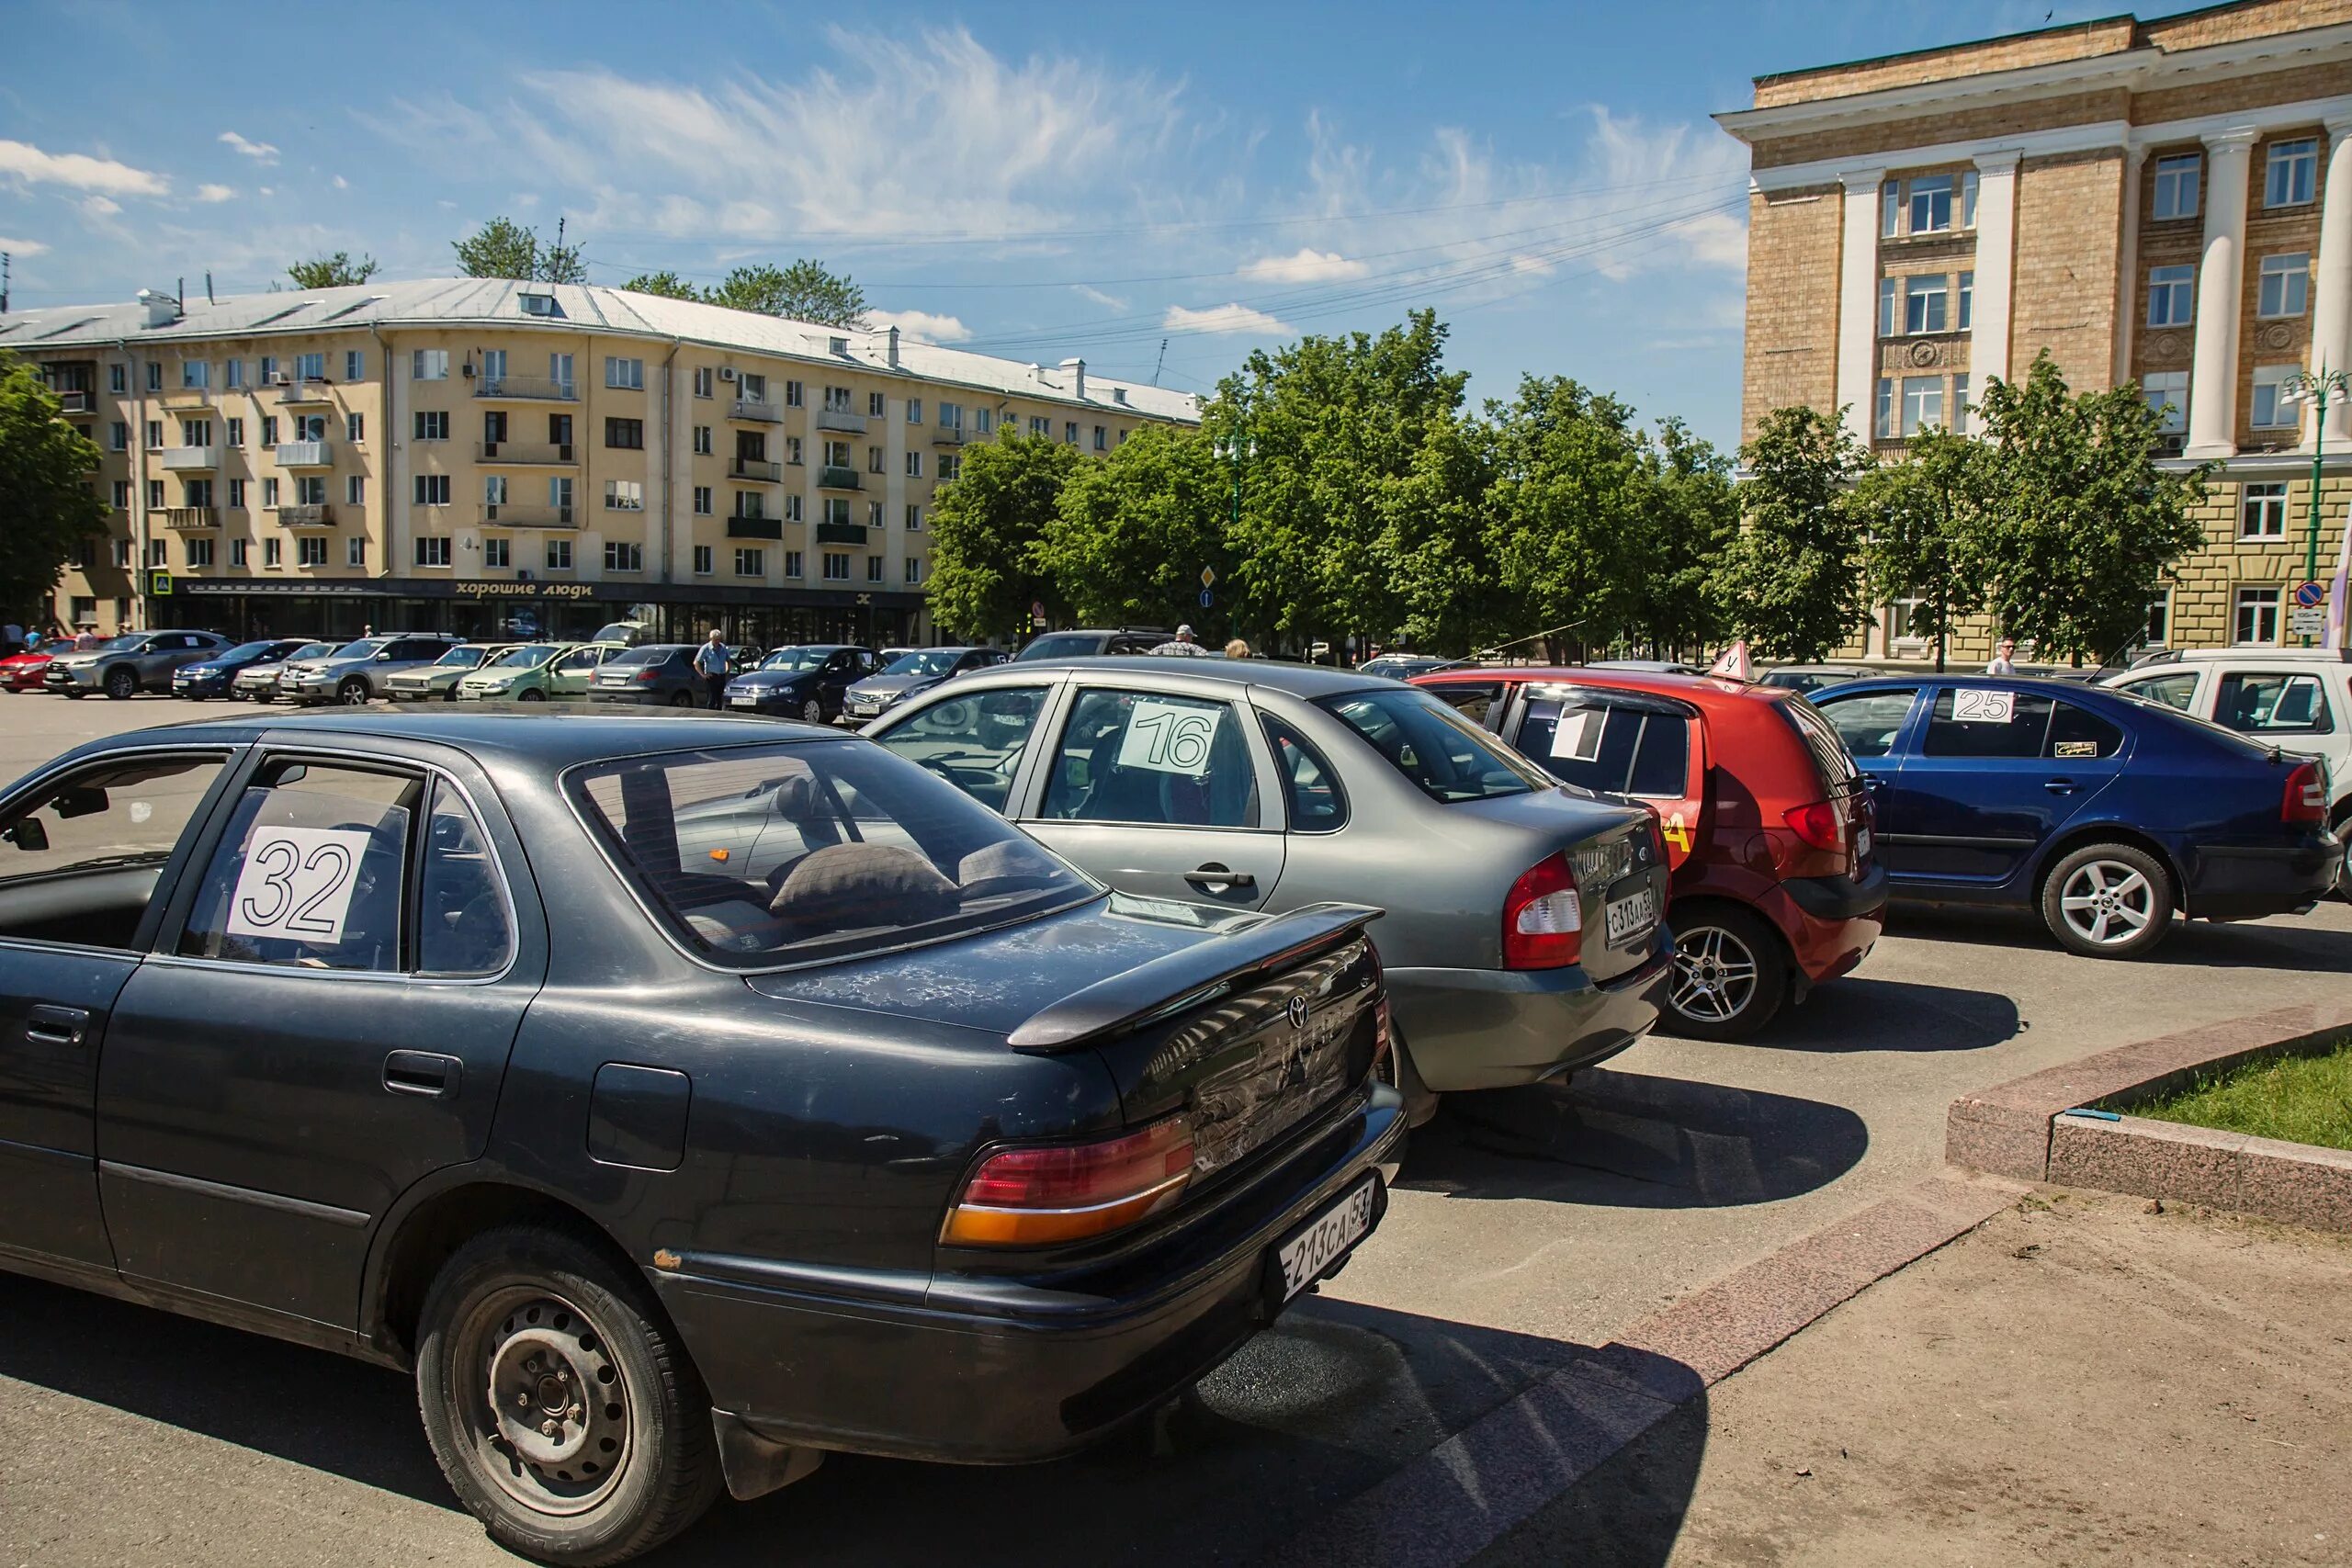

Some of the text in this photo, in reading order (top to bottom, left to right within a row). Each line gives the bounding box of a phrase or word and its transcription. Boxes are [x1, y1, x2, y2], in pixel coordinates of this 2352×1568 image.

[457, 583, 593, 599] хорошие люди
[1957, 691, 2008, 719] 25
[1136, 712, 1212, 768] 16
[243, 840, 351, 933] 32
